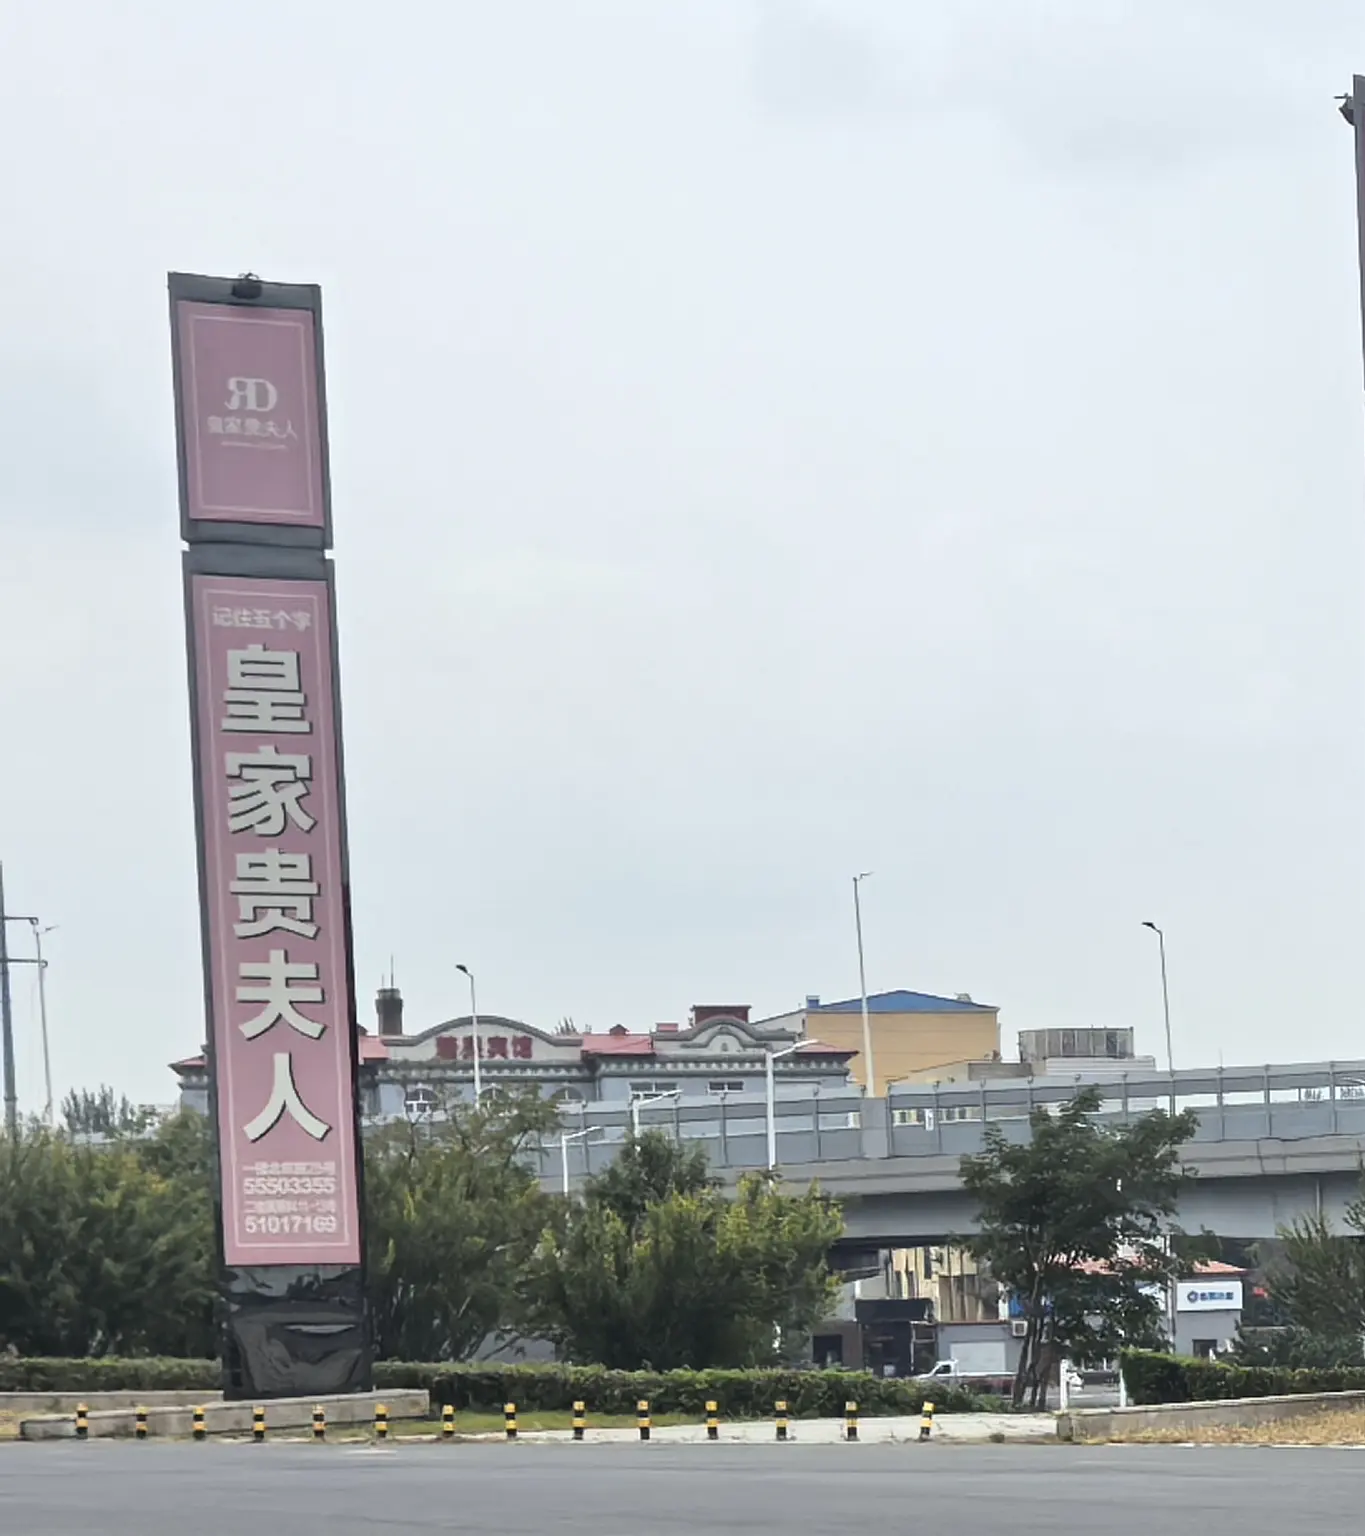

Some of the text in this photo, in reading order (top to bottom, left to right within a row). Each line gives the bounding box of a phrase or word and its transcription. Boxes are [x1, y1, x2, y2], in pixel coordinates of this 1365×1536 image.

[221, 643, 332, 1145] 皇家贵夫人
